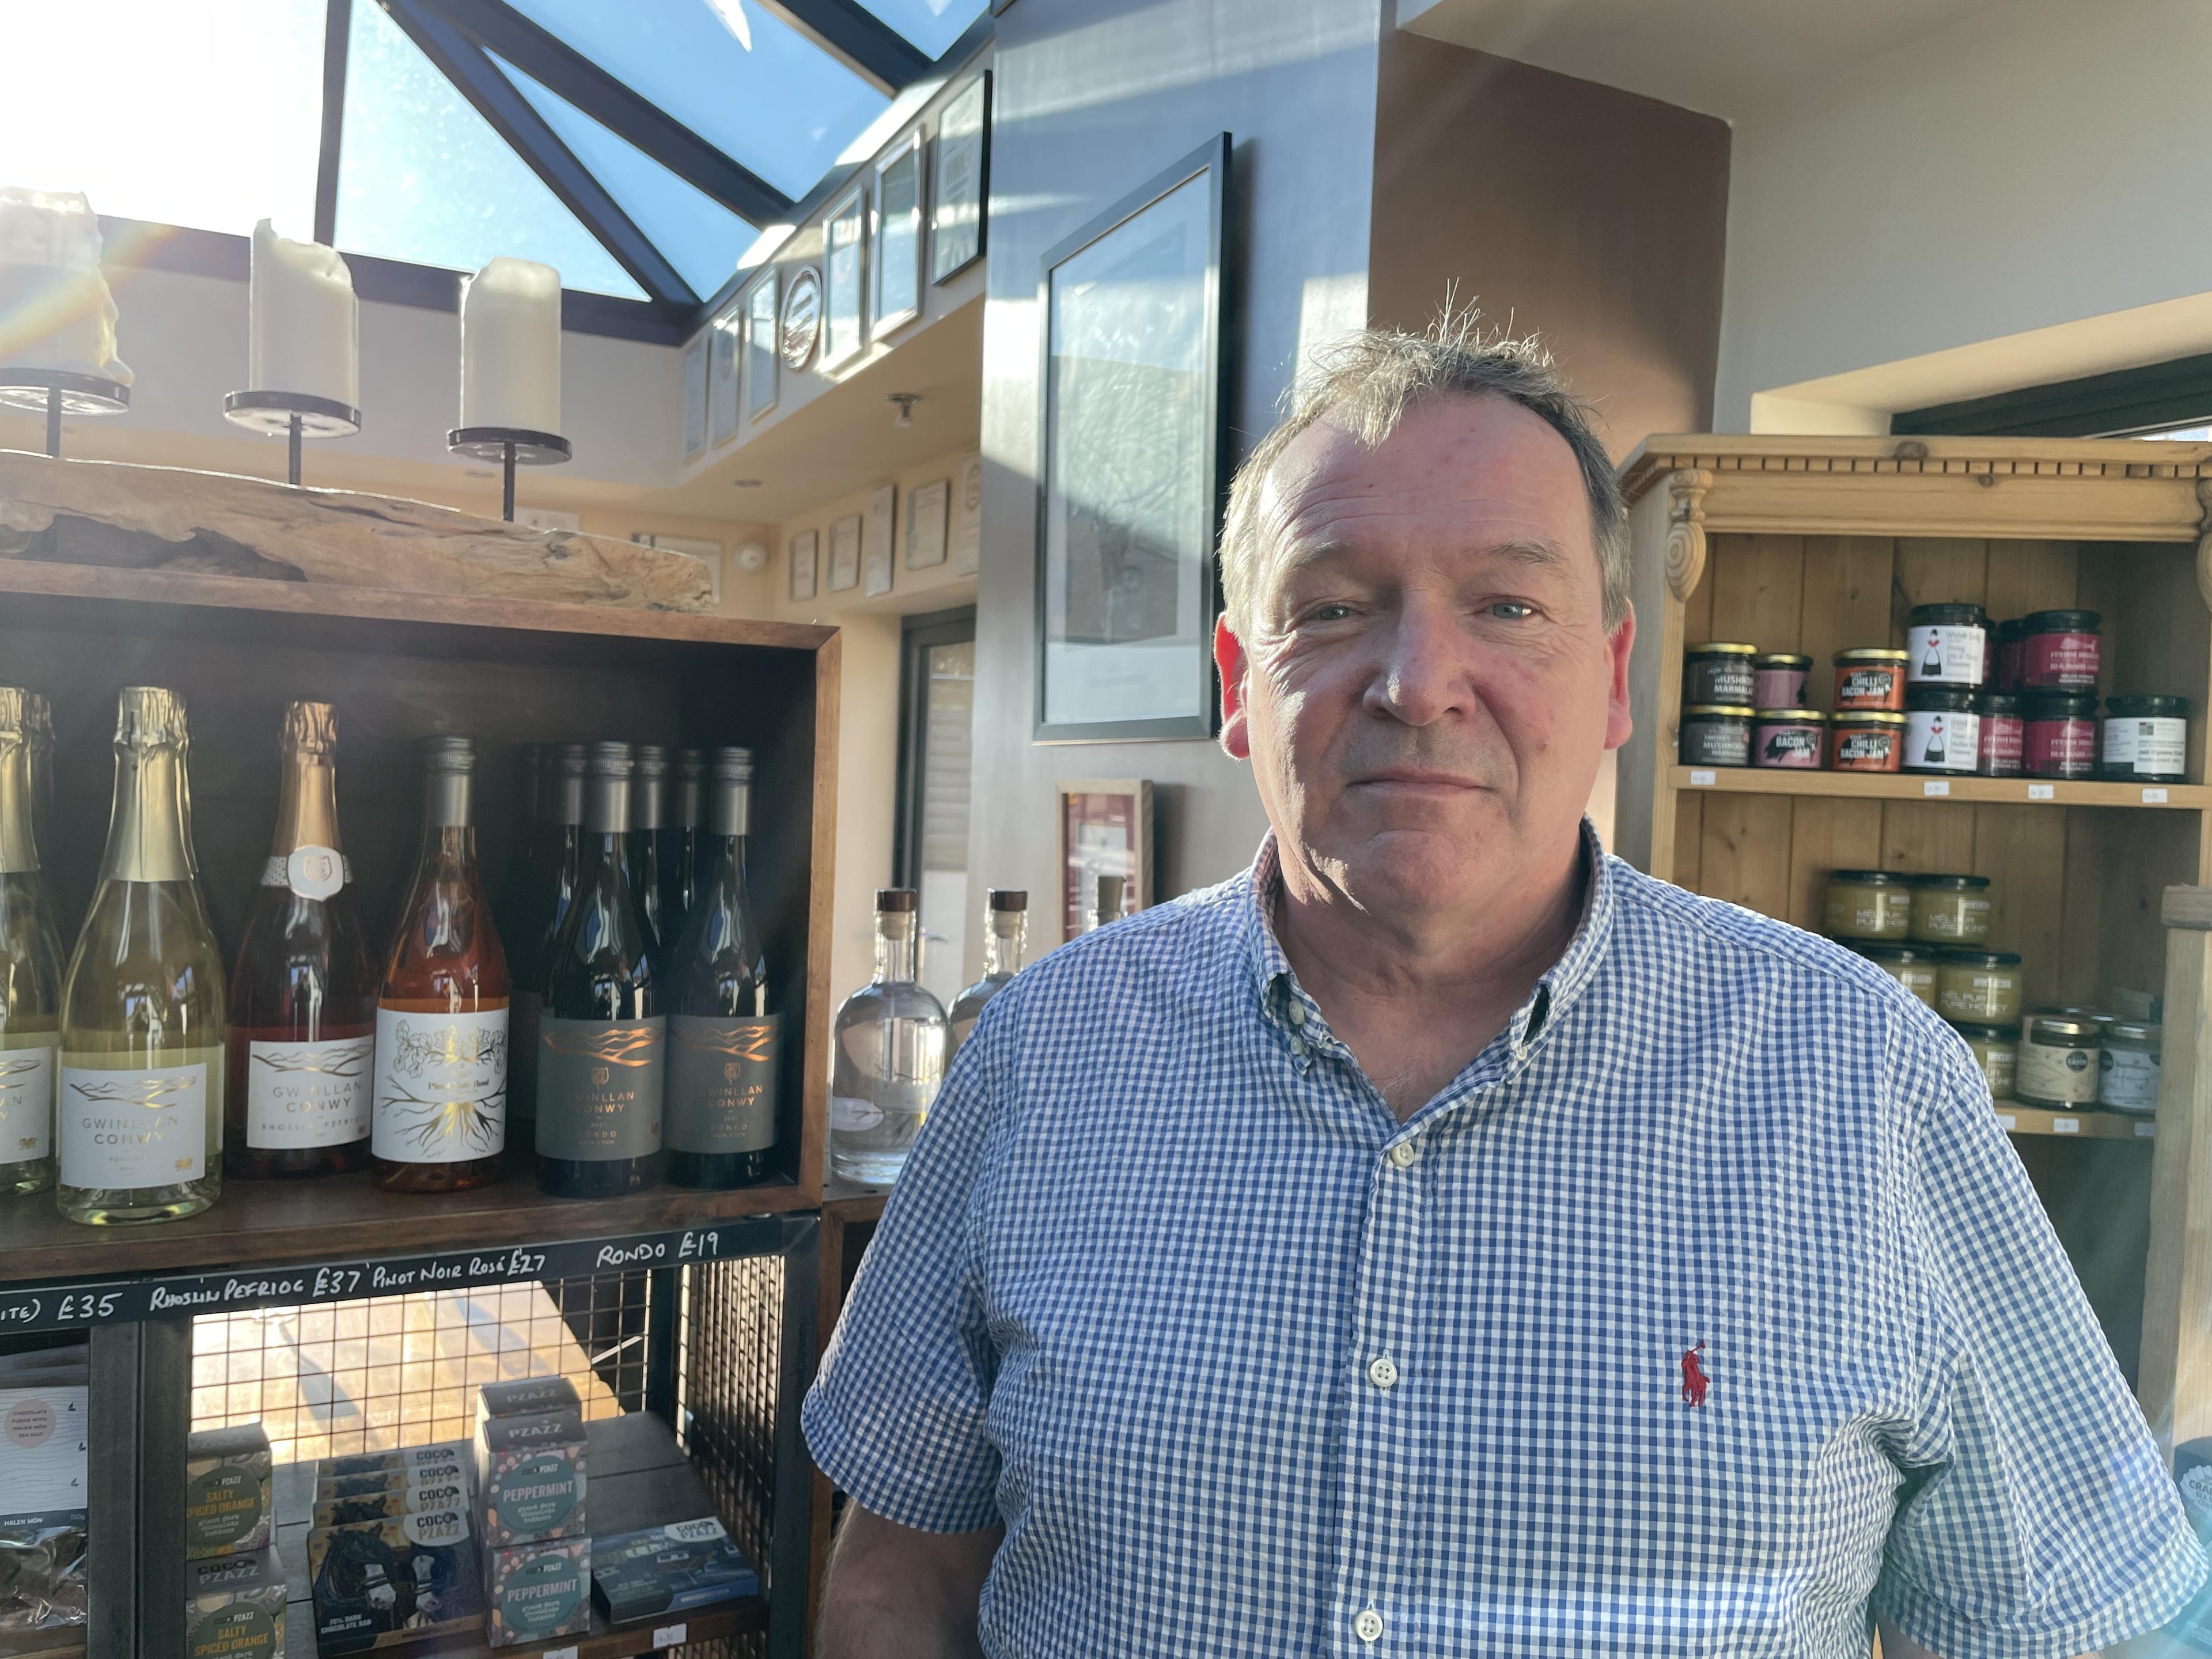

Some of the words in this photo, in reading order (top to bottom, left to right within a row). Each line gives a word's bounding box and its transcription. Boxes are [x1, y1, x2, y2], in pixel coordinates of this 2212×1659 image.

[1852, 676, 1877, 686] CHILLI
[1842, 685, 1865, 697] BACON
[1866, 685, 1884, 696] JAM
[1776, 735, 1805, 748] BACON
[1851, 738, 1877, 749] CHILLI
[1793, 747, 1811, 759] JAM
[1840, 748, 1865, 759] BACON
[1867, 748, 1884, 759] JAM
[286, 1097, 351, 1112] CONWY
[94, 1131, 165, 1145] CONWY
[596, 1243, 665, 1268] RONDO
[678, 1231, 719, 1259] £19
[373, 1266, 416, 1289] PINOT
[420, 1261, 462, 1281] NOIR
[507, 1249, 546, 1277] £27
[224, 1278, 304, 1301] PEFRIOG
[312, 1267, 361, 1298] £37
[58, 1293, 124, 1320] £35
[509, 1423, 563, 1438] PZAZZ
[416, 1449, 453, 1460] COCO
[419, 1465, 456, 1478] COCO
[207, 1488, 234, 1503] SALTY
[419, 1486, 457, 1501] COCO
[503, 1480, 574, 1503] PEPPERMINT
[219, 1497, 255, 1513] ORANGE
[417, 1512, 456, 1527] COCO
[418, 1525, 461, 1541] PZAZZ
[198, 1559, 251, 1575] COCO
[199, 1566, 259, 1585] PZAZZ
[507, 1579, 577, 1603] PEPPERMINT
[233, 1612, 254, 1622] PZAZZ
[359, 1618, 372, 1627] BAR
[218, 1625, 248, 1640] SALTY
[195, 1641, 229, 1657] SPICED
[232, 1633, 269, 1650] ORANGE
